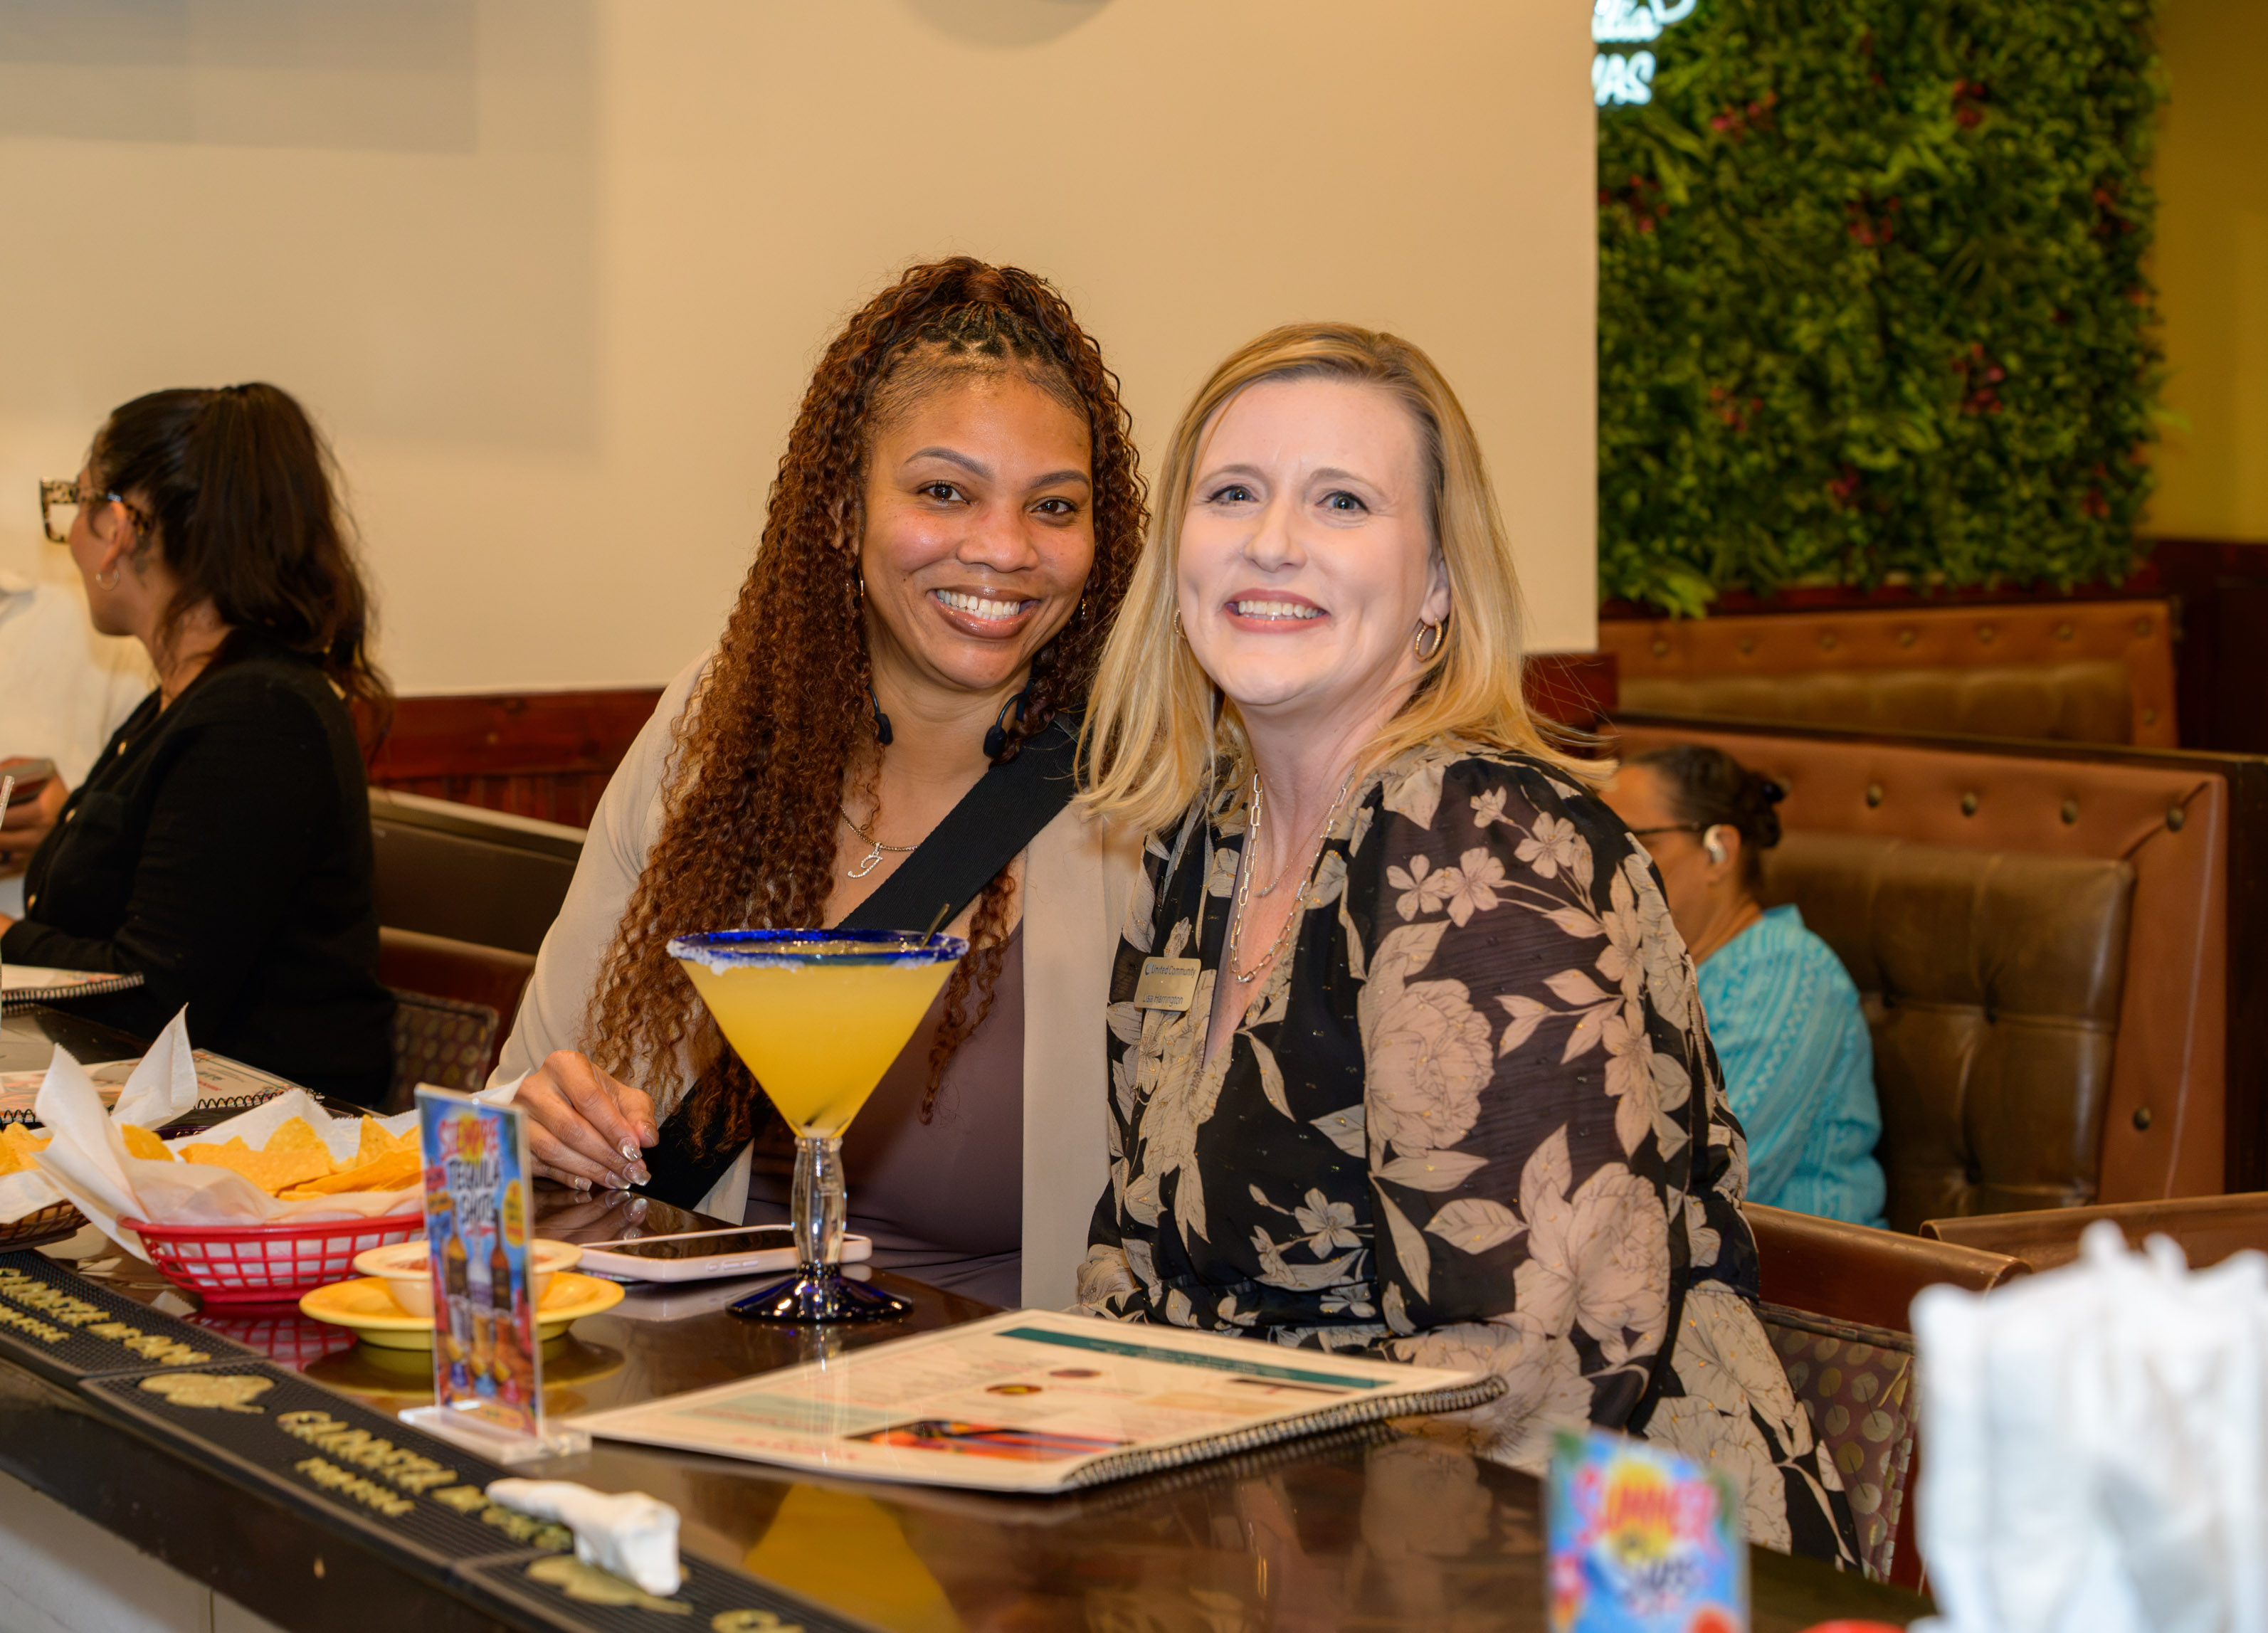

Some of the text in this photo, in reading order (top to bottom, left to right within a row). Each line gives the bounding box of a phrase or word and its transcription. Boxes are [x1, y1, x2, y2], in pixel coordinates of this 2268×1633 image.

[1151, 964, 1196, 978] United Community
[1143, 993, 1154, 1003] Lisa
[448, 1158, 500, 1190] TEQUILA
